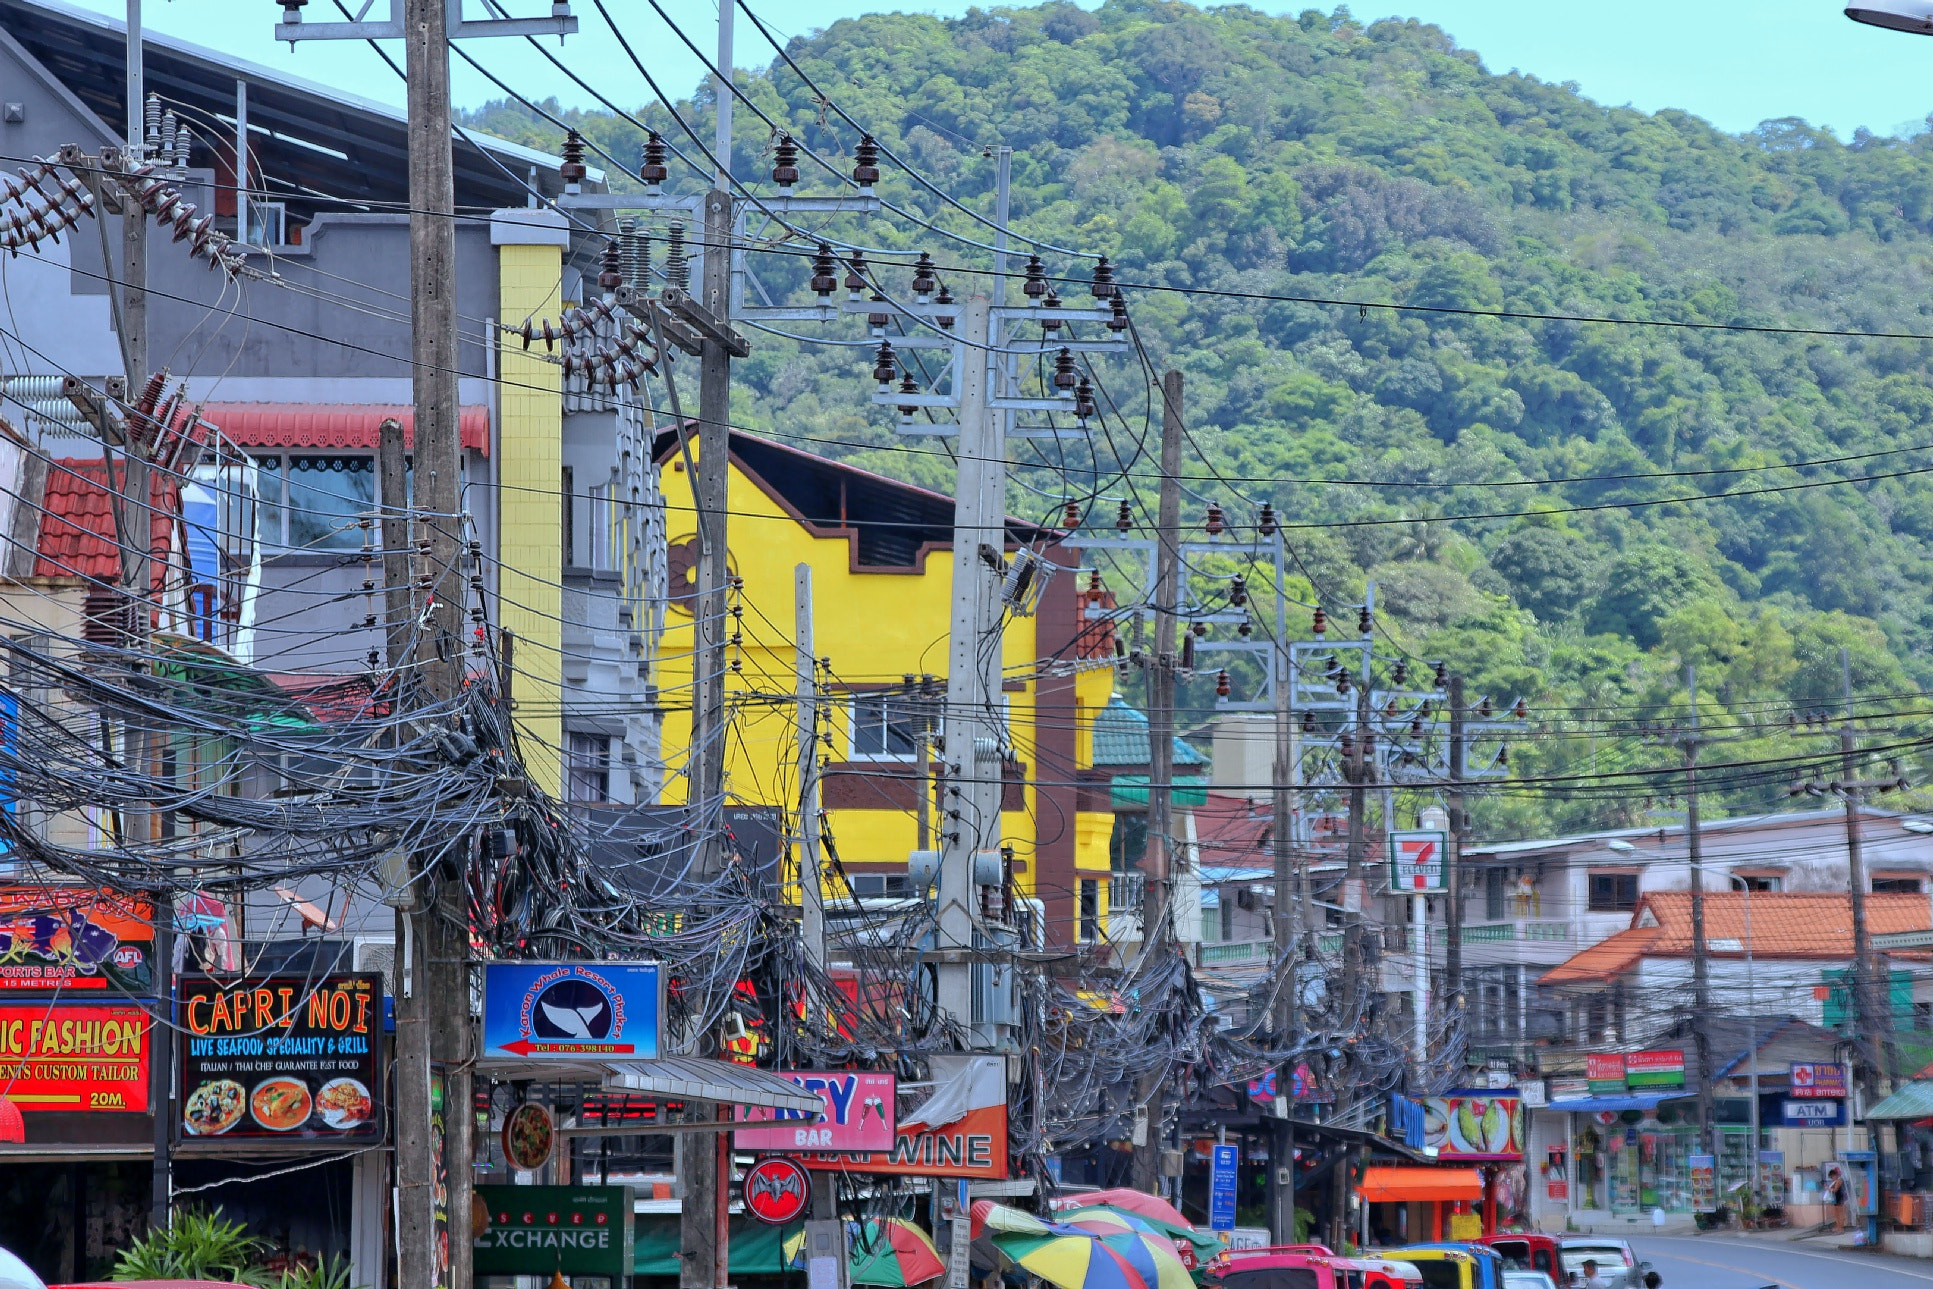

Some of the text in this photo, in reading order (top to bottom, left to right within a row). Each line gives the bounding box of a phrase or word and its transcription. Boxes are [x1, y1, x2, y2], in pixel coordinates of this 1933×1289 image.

[114, 951, 142, 964] AFL
[45, 966, 76, 978] BAR
[3, 979, 72, 987] 15 METRES
[188, 988, 371, 1035] CAPRI NOI
[519, 966, 628, 1040] Karon Whale Resort Phuket
[30, 1020, 142, 1055] FASHION
[191, 1037, 214, 1057] LIVE
[216, 1037, 264, 1057] SEAFOOD
[267, 1036, 326, 1056] SPECIALITY
[338, 1036, 369, 1055] GRILL
[535, 1044, 550, 1053] Tel
[34, 1064, 88, 1080] CUSTOM
[91, 1065, 139, 1081] TAILOR
[200, 1061, 228, 1072] ITALIAN
[235, 1061, 254, 1072] THAI
[255, 1061, 273, 1071] CHEF
[275, 1061, 318, 1071] GUARANTEE
[338, 1061, 359, 1070] FOOD
[1797, 1105, 1828, 1117] ATM
[795, 1129, 833, 1147] BAR
[888, 1134, 992, 1168] WINE
